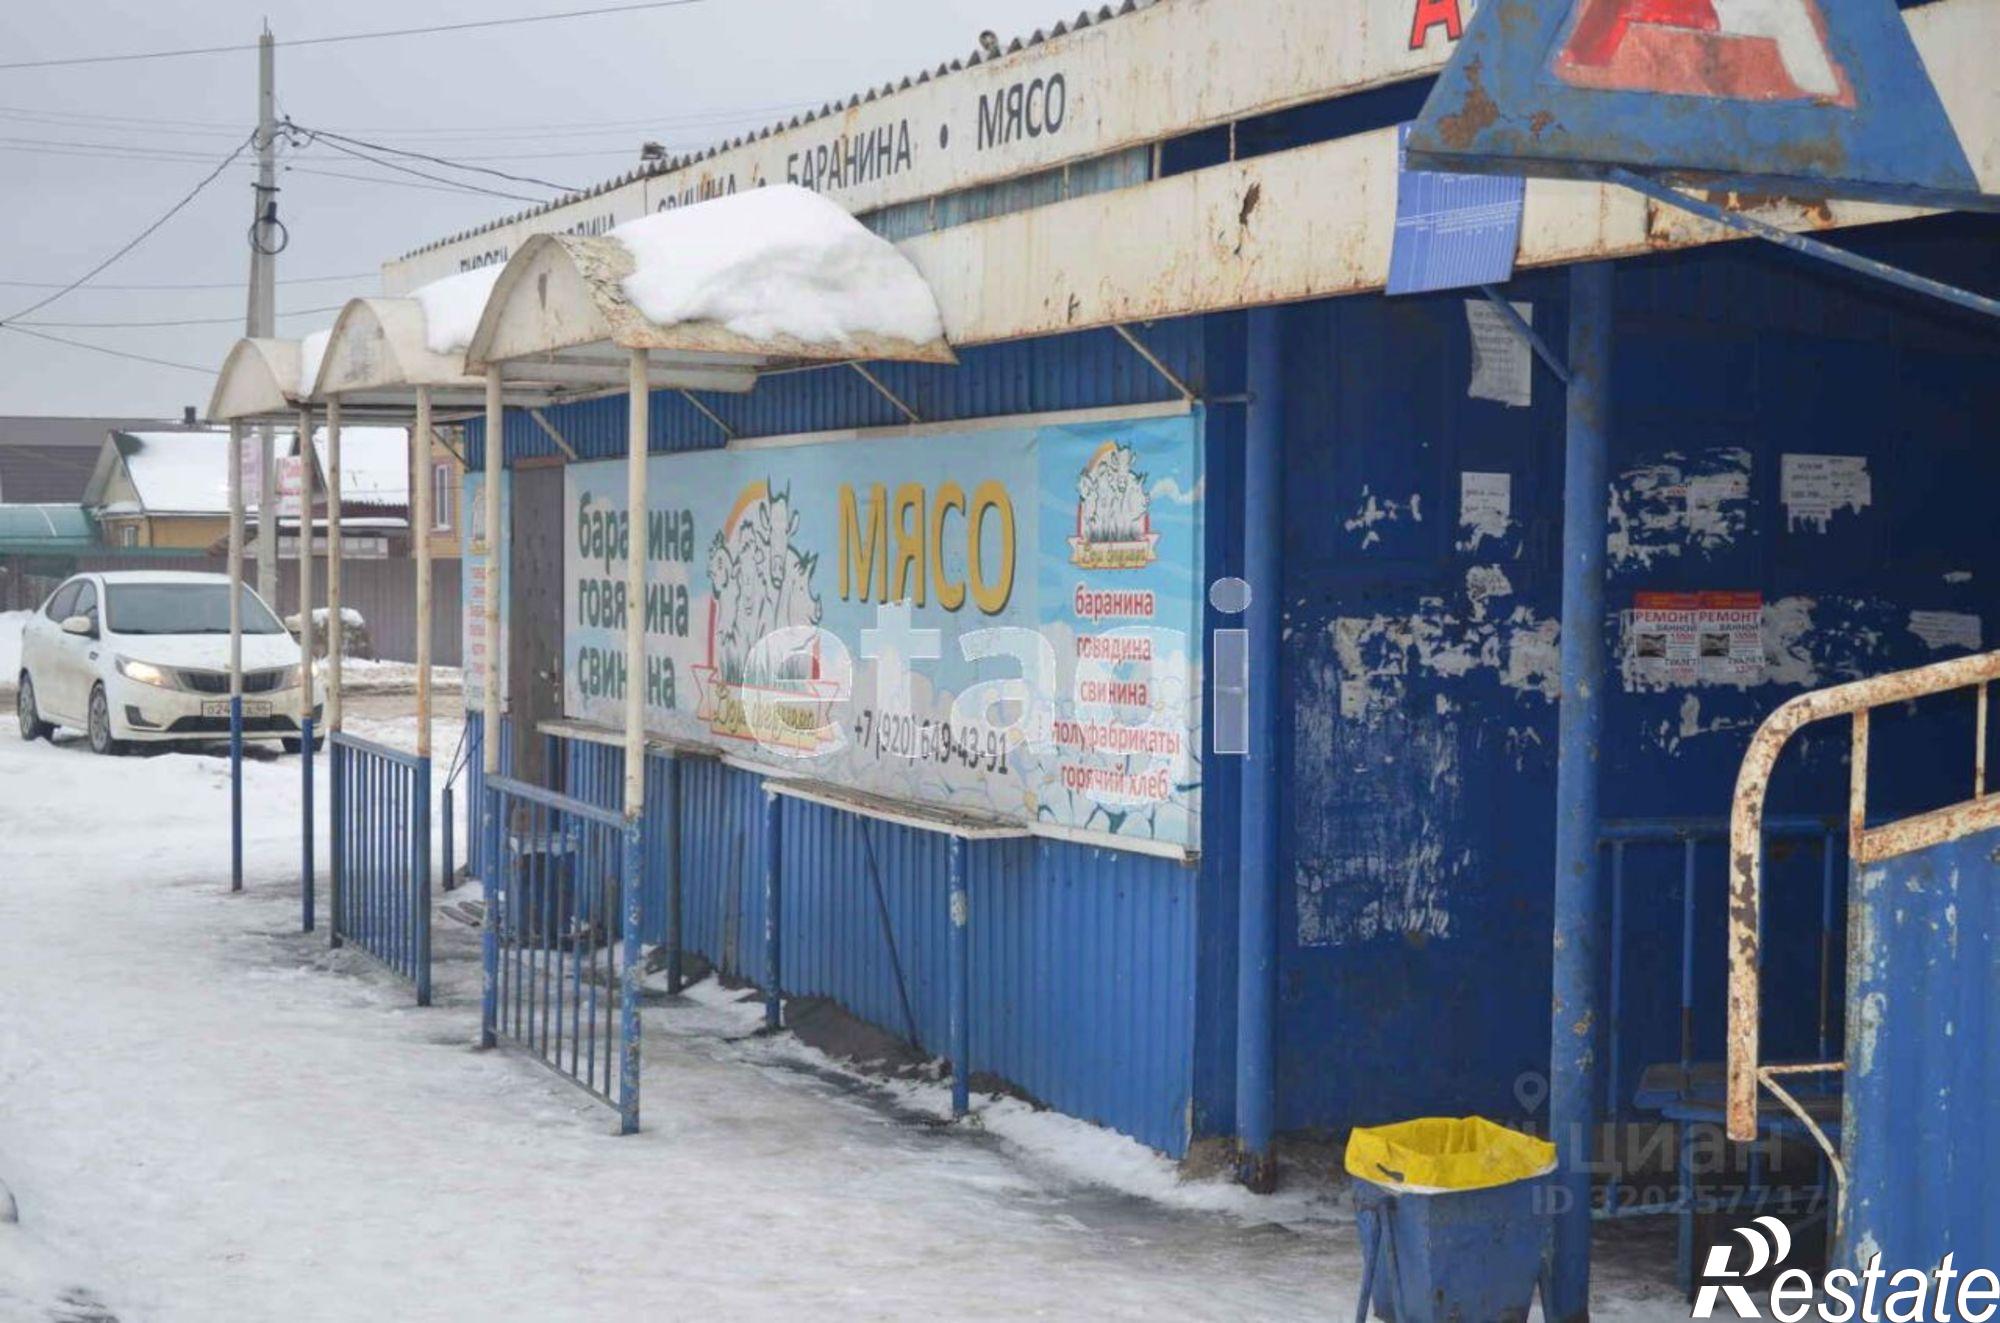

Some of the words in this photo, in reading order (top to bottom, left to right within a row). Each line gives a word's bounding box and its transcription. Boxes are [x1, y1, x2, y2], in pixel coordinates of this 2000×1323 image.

[787, 118, 911, 192] БАРАНИНА
[977, 72, 1066, 151] МЯСО
[578, 491, 695, 575] бараина
[837, 479, 1017, 617] МЯСО
[578, 579, 689, 638] говяина
[1075, 585, 1154, 620] баранина
[1635, 611, 1697, 623] РЕМОНТ
[1699, 611, 1758, 623] РЕМОНТ
[1076, 636, 1152, 666] говядина
[578, 646, 676, 710] свинна
[1080, 680, 1149, 706] свинина
[854, 709, 873, 748] +7
[875, 710, 916, 767] (920)
[921, 719, 1009, 775] 649-43-91
[1053, 716, 1180, 756] полуфабрикаты
[1061, 763, 1125, 794] горячий
[1129, 769, 1169, 800] хлеб
